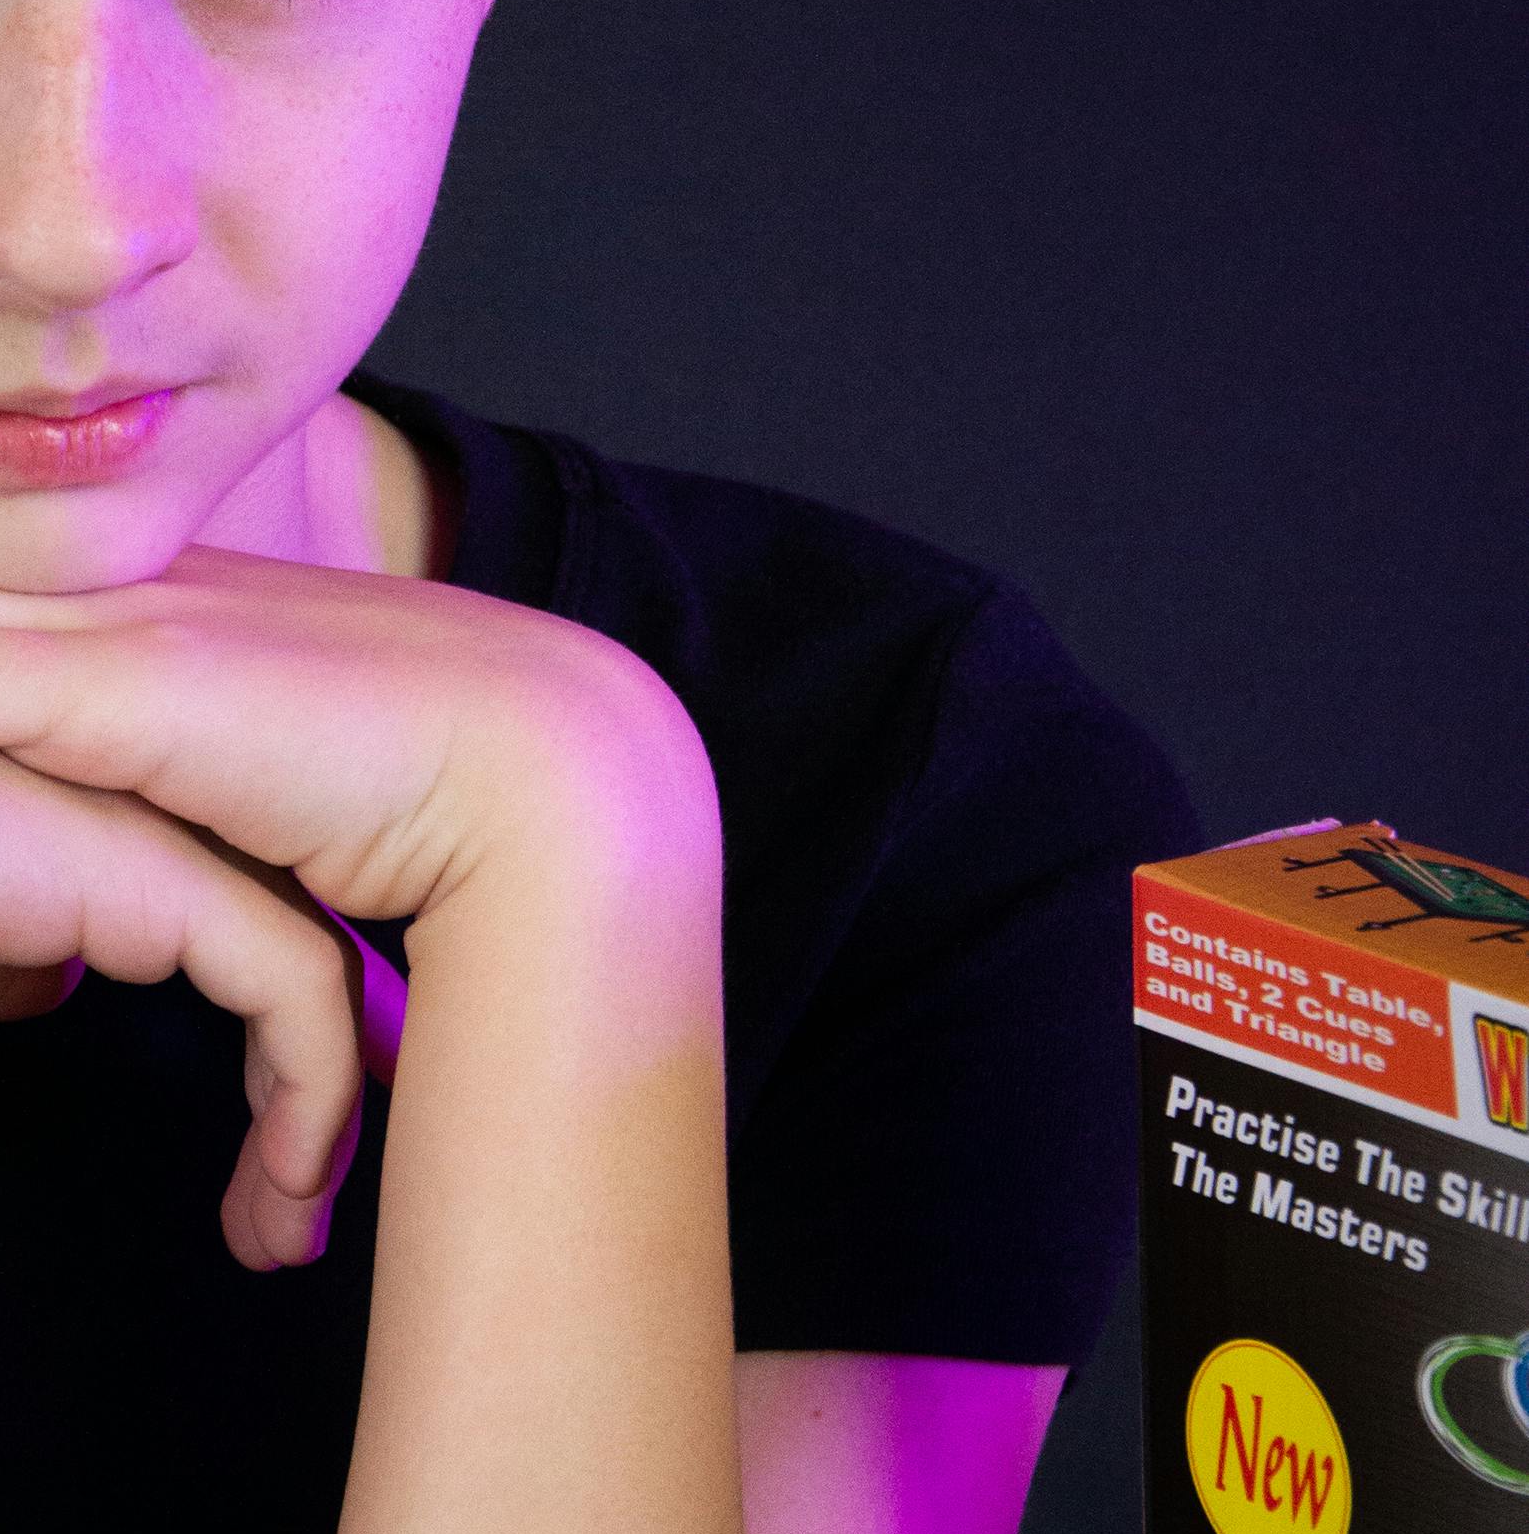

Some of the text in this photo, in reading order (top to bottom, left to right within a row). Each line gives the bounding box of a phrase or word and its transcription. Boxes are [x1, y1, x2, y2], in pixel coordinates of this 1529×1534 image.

[1144, 911, 1445, 1037] Contains Table,
[1144, 941, 1395, 1046] Balls, 2 Cues
[1145, 975, 1386, 1073] and Triangle
[1165, 1074, 1340, 1174] Practise
[1355, 1138, 1427, 1204] The
[1171, 1142, 1430, 1273] The Masters
[1215, 1381, 1335, 1530] New
